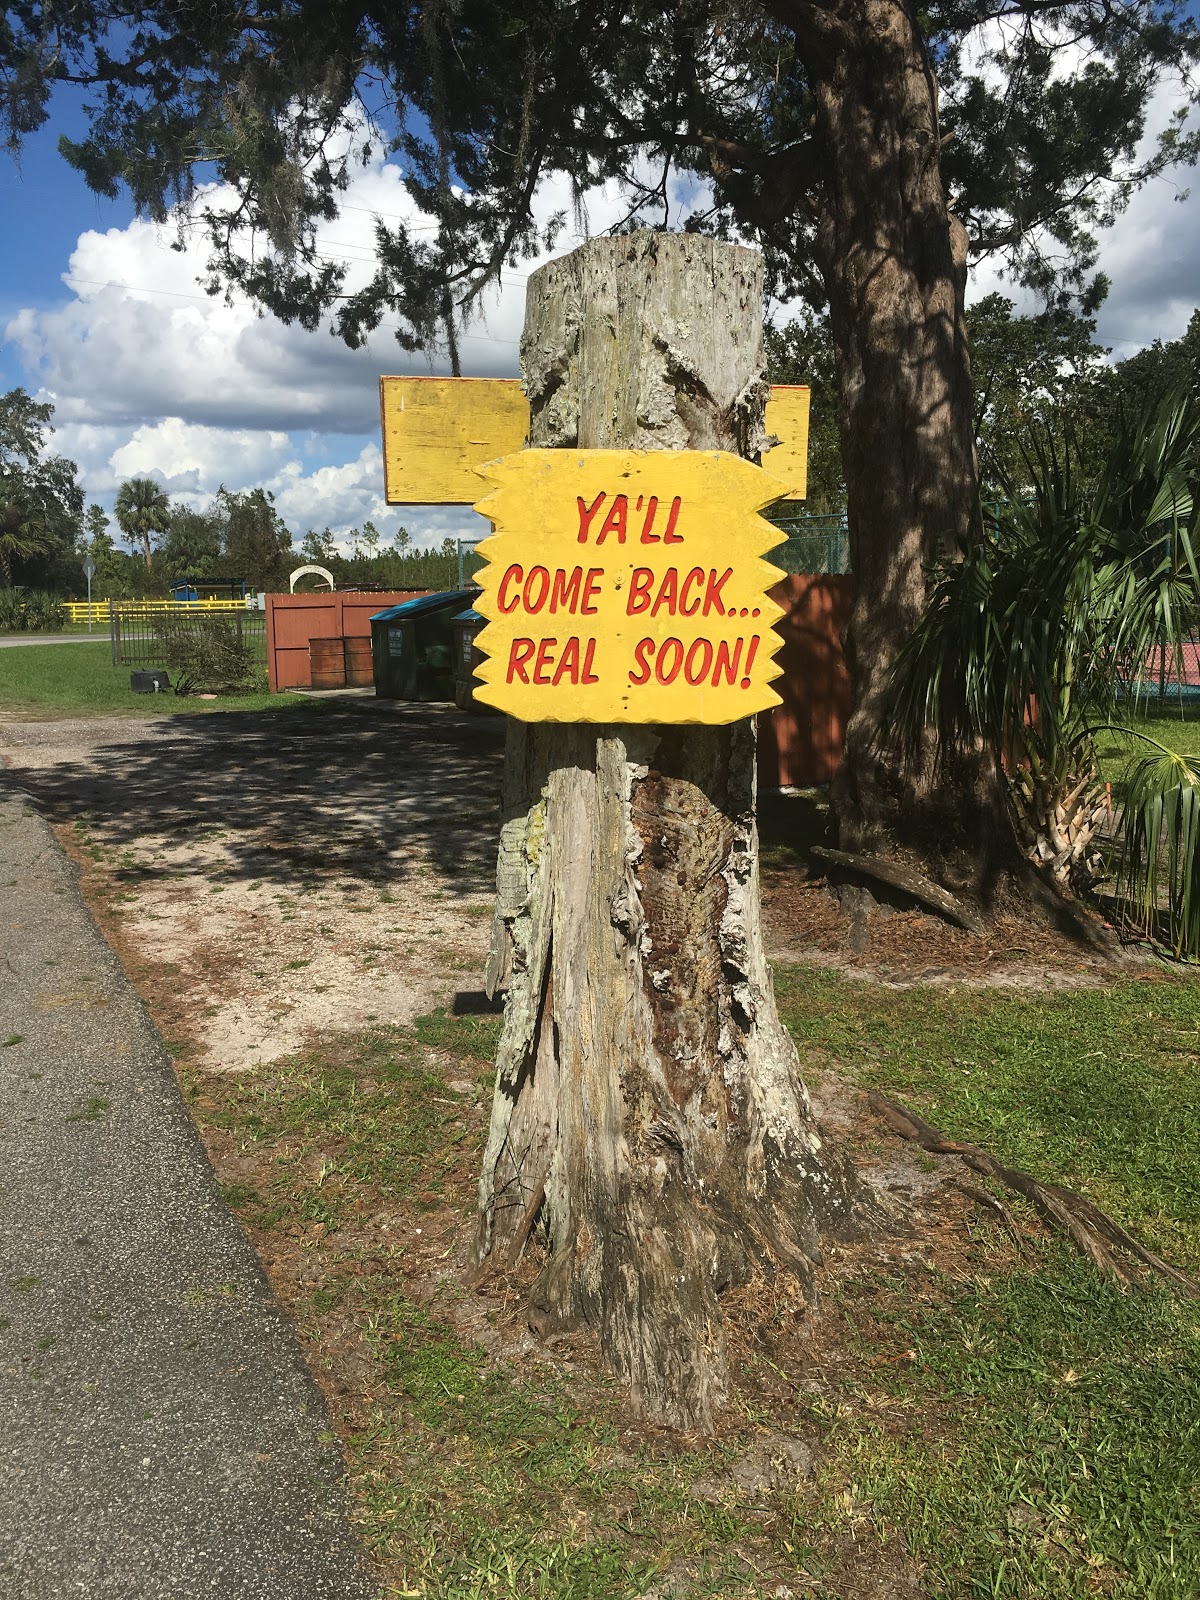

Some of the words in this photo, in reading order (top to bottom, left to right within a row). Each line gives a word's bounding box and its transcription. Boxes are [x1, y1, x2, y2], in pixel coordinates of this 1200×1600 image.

[576, 491, 685, 546] YA'LL
[496, 563, 605, 616] COME
[625, 566, 762, 619] BACK...
[505, 636, 600, 687] REAL
[627, 634, 761, 691] SOON!
